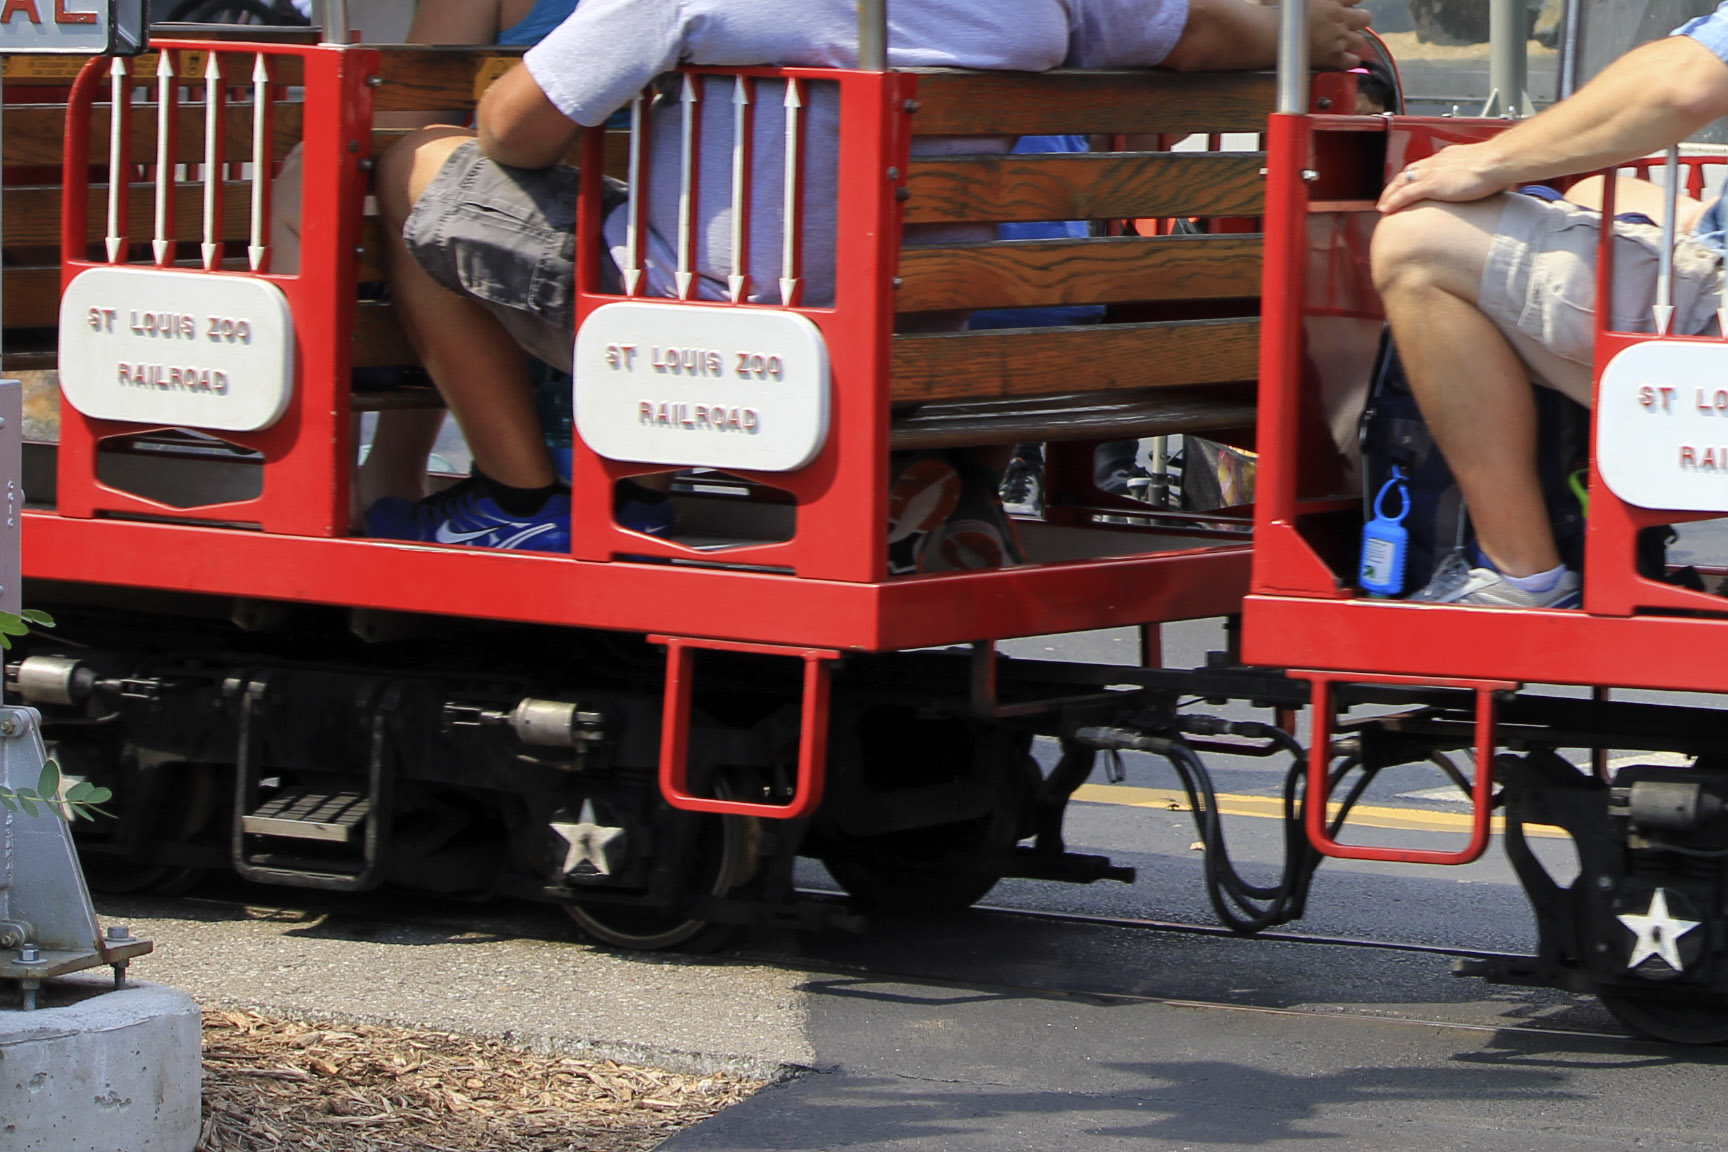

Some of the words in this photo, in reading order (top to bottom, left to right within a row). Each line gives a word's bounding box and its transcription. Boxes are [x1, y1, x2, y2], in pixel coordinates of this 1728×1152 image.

[87, 306, 116, 331] ST
[130, 309, 194, 337] LOUIS
[206, 315, 252, 343] ZOO
[118, 362, 229, 393] RAILROAD
[605, 343, 637, 370] ST
[651, 345, 723, 375] LOUIS
[735, 351, 784, 379] ZOO
[1637, 385, 1676, 410] ST
[638, 399, 760, 433] RAILROAD
